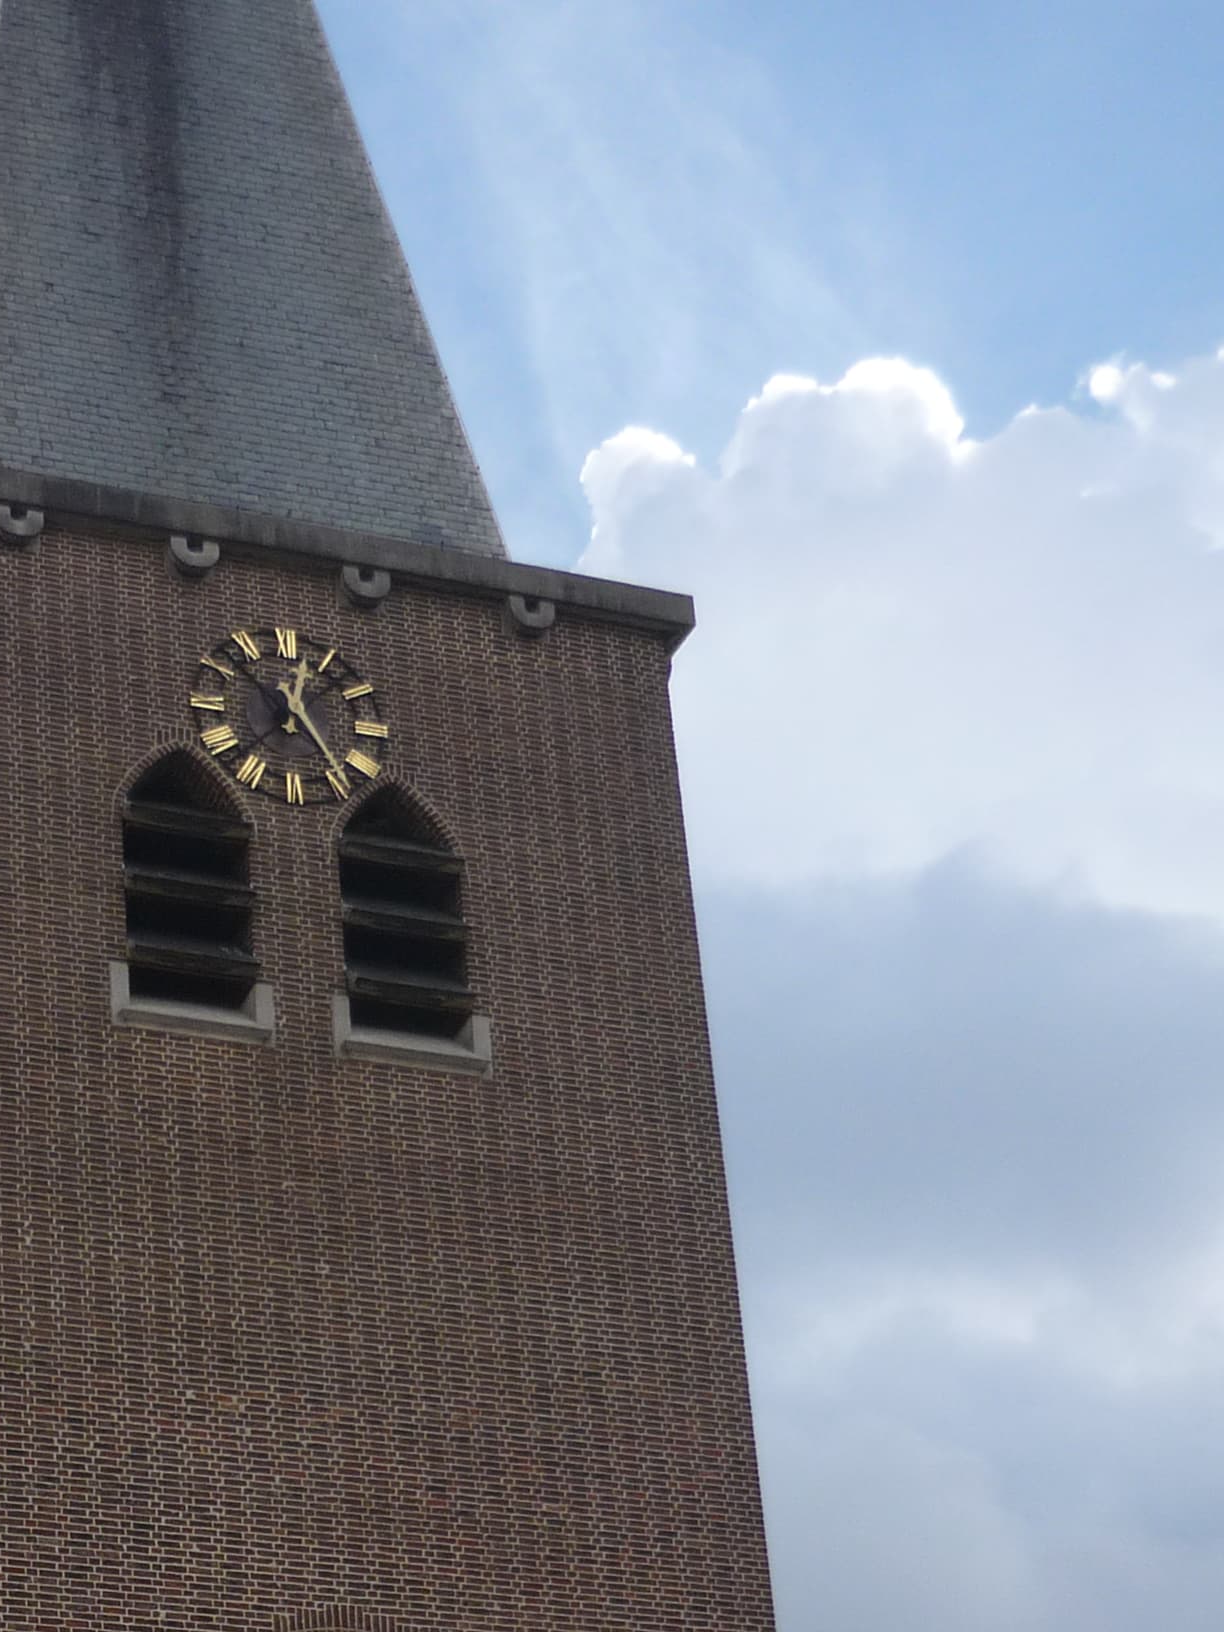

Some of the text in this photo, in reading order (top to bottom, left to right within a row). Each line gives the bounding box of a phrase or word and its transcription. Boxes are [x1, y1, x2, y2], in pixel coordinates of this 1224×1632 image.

[275, 627, 297, 660] XII
[318, 649, 335, 673] I
[342, 683, 374, 700] II
[200, 724, 239, 755] VIII
[355, 720, 388, 738] III
[236, 754, 266, 790] VII
